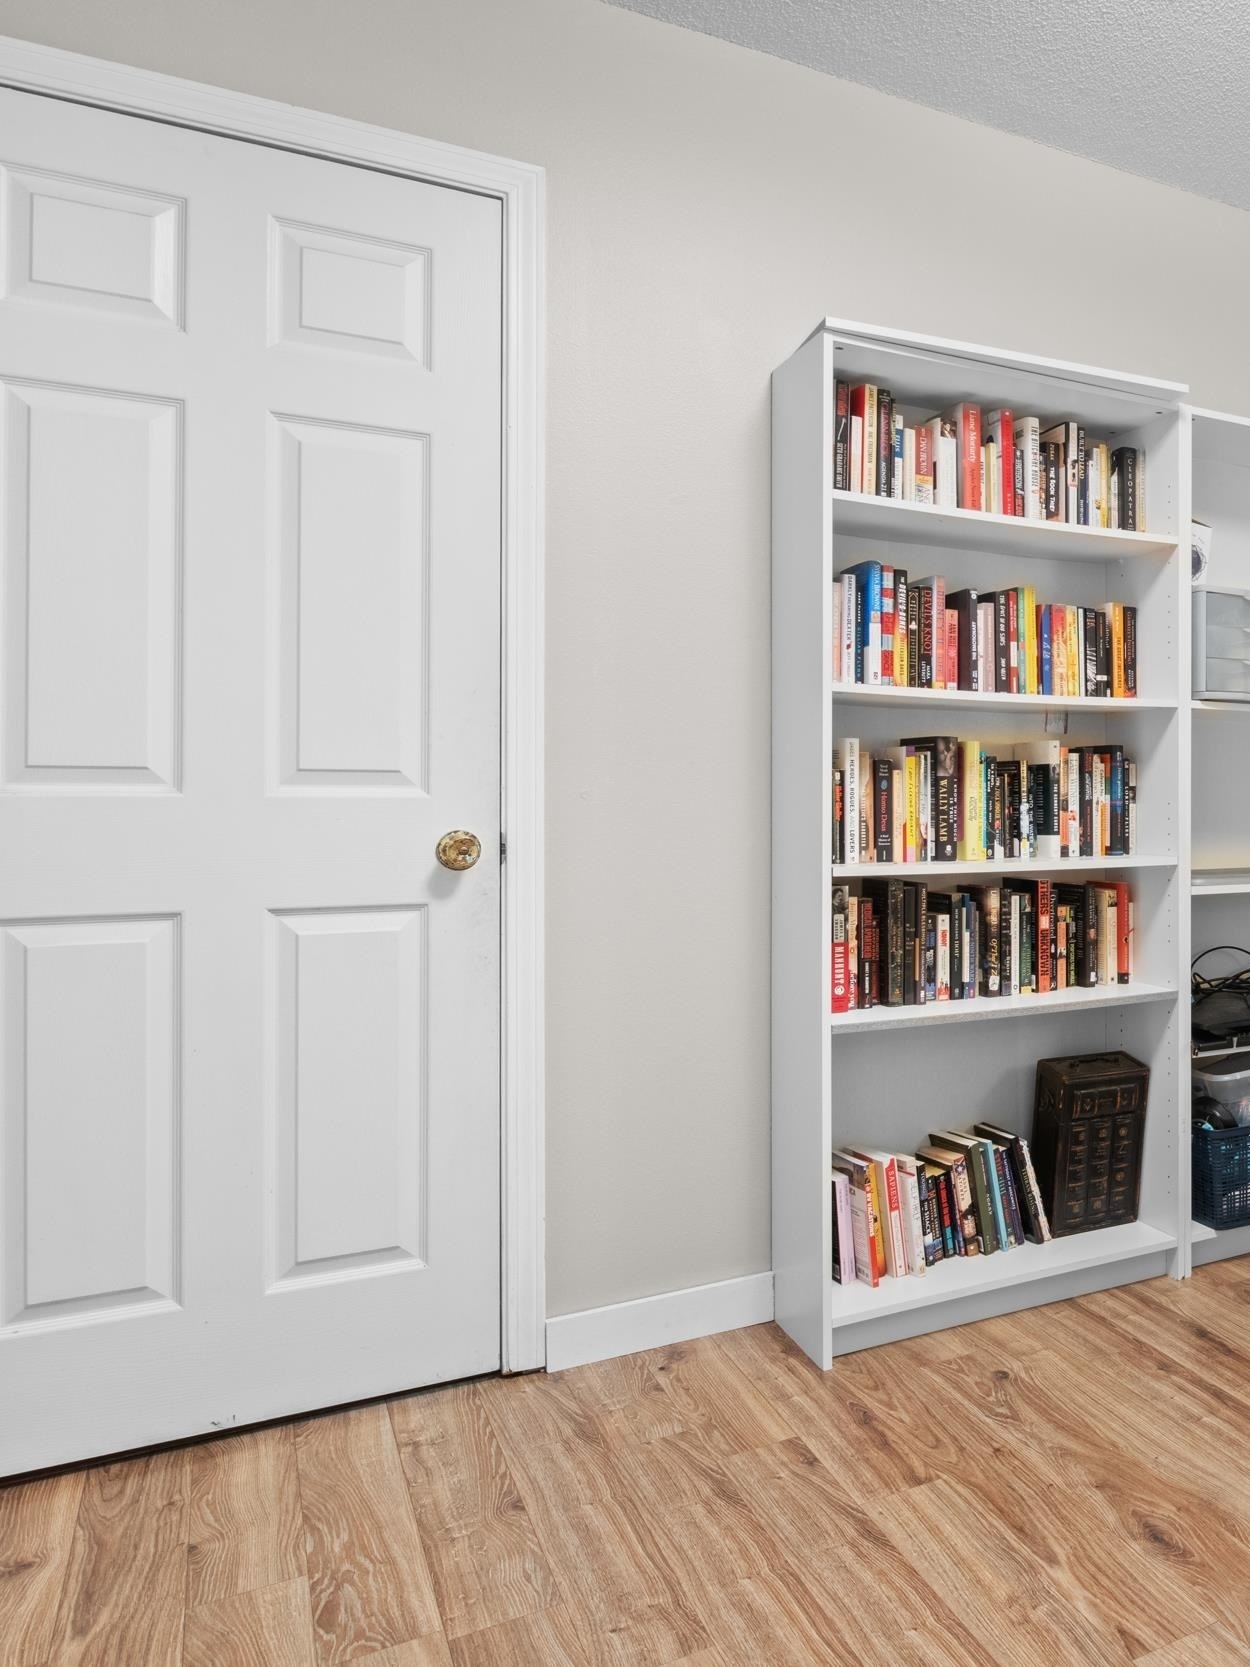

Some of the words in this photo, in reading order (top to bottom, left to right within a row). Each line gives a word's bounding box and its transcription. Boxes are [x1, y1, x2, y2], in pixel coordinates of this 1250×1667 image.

[969, 410, 977, 430] Liane
[967, 431, 976, 464] Moriarty
[1079, 451, 1086, 461] TO
[924, 590, 932, 623] DEVIL'S
[924, 627, 932, 657] KNOT
[939, 779, 948, 812] WALLY
[939, 815, 948, 842] LAMB
[1040, 880, 1049, 915] OTHERS
[864, 902, 872, 926] MEDICAL
[864, 928, 872, 959] APARTHEID
[1040, 929, 1049, 977] UNKNOWN
[834, 946, 845, 984] MANHUNT
[849, 970, 857, 992] before
[848, 993, 856, 1008] you
[888, 1170, 898, 1209] SAPIENS
[1021, 1168, 1031, 1192] TEHRAN
[865, 1193, 872, 1203] RV
[866, 1203, 874, 1237] VACATIONS
